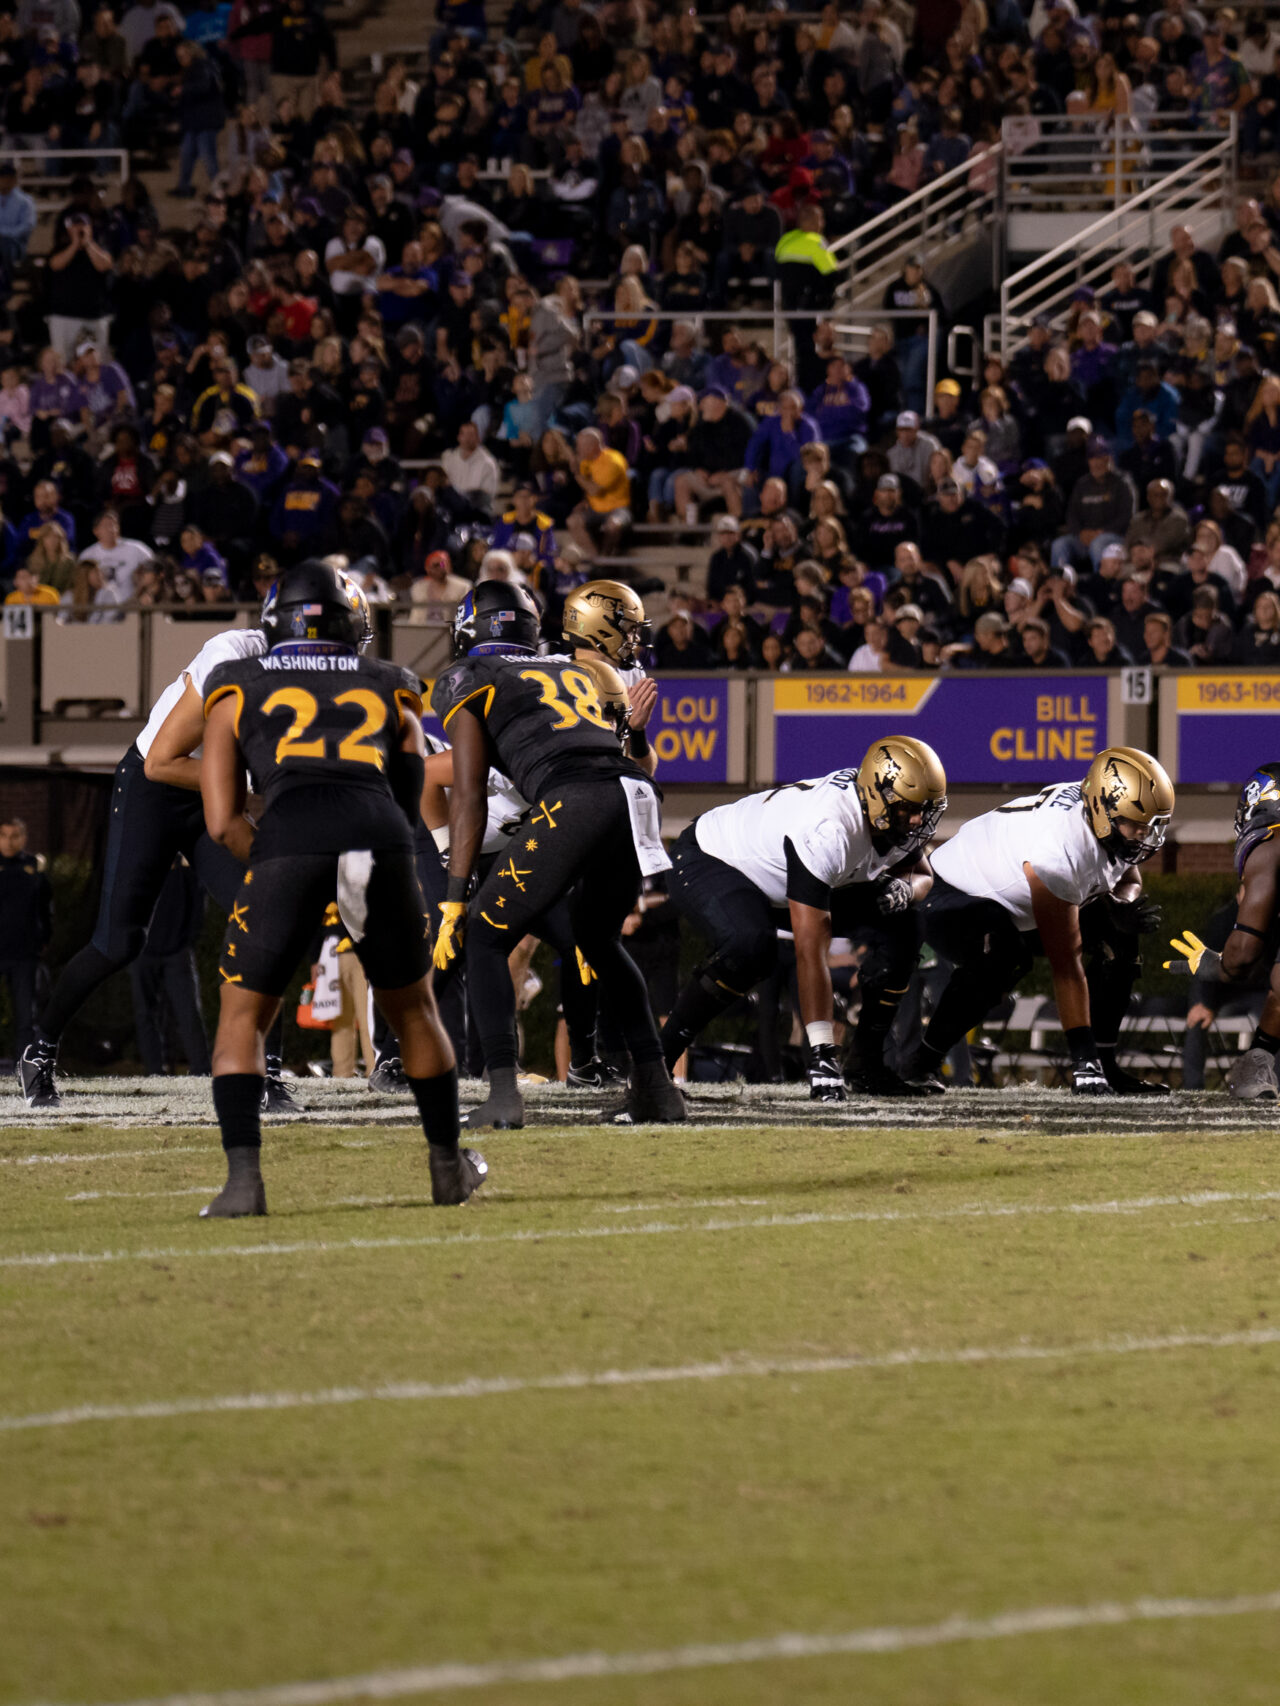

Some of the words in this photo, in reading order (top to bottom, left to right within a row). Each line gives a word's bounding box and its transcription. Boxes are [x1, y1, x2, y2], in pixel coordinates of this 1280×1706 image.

[9, 610, 26, 634] 14
[258, 655, 359, 671] WASHINGTON
[805, 683, 907, 703] 1962-1964
[1127, 672, 1146, 698] 15
[518, 669, 616, 732] 38
[662, 696, 718, 723] LOU
[1036, 696, 1096, 722] BILL
[260, 686, 384, 772] 22
[655, 729, 717, 761] OW
[989, 729, 1096, 760] CLINE
